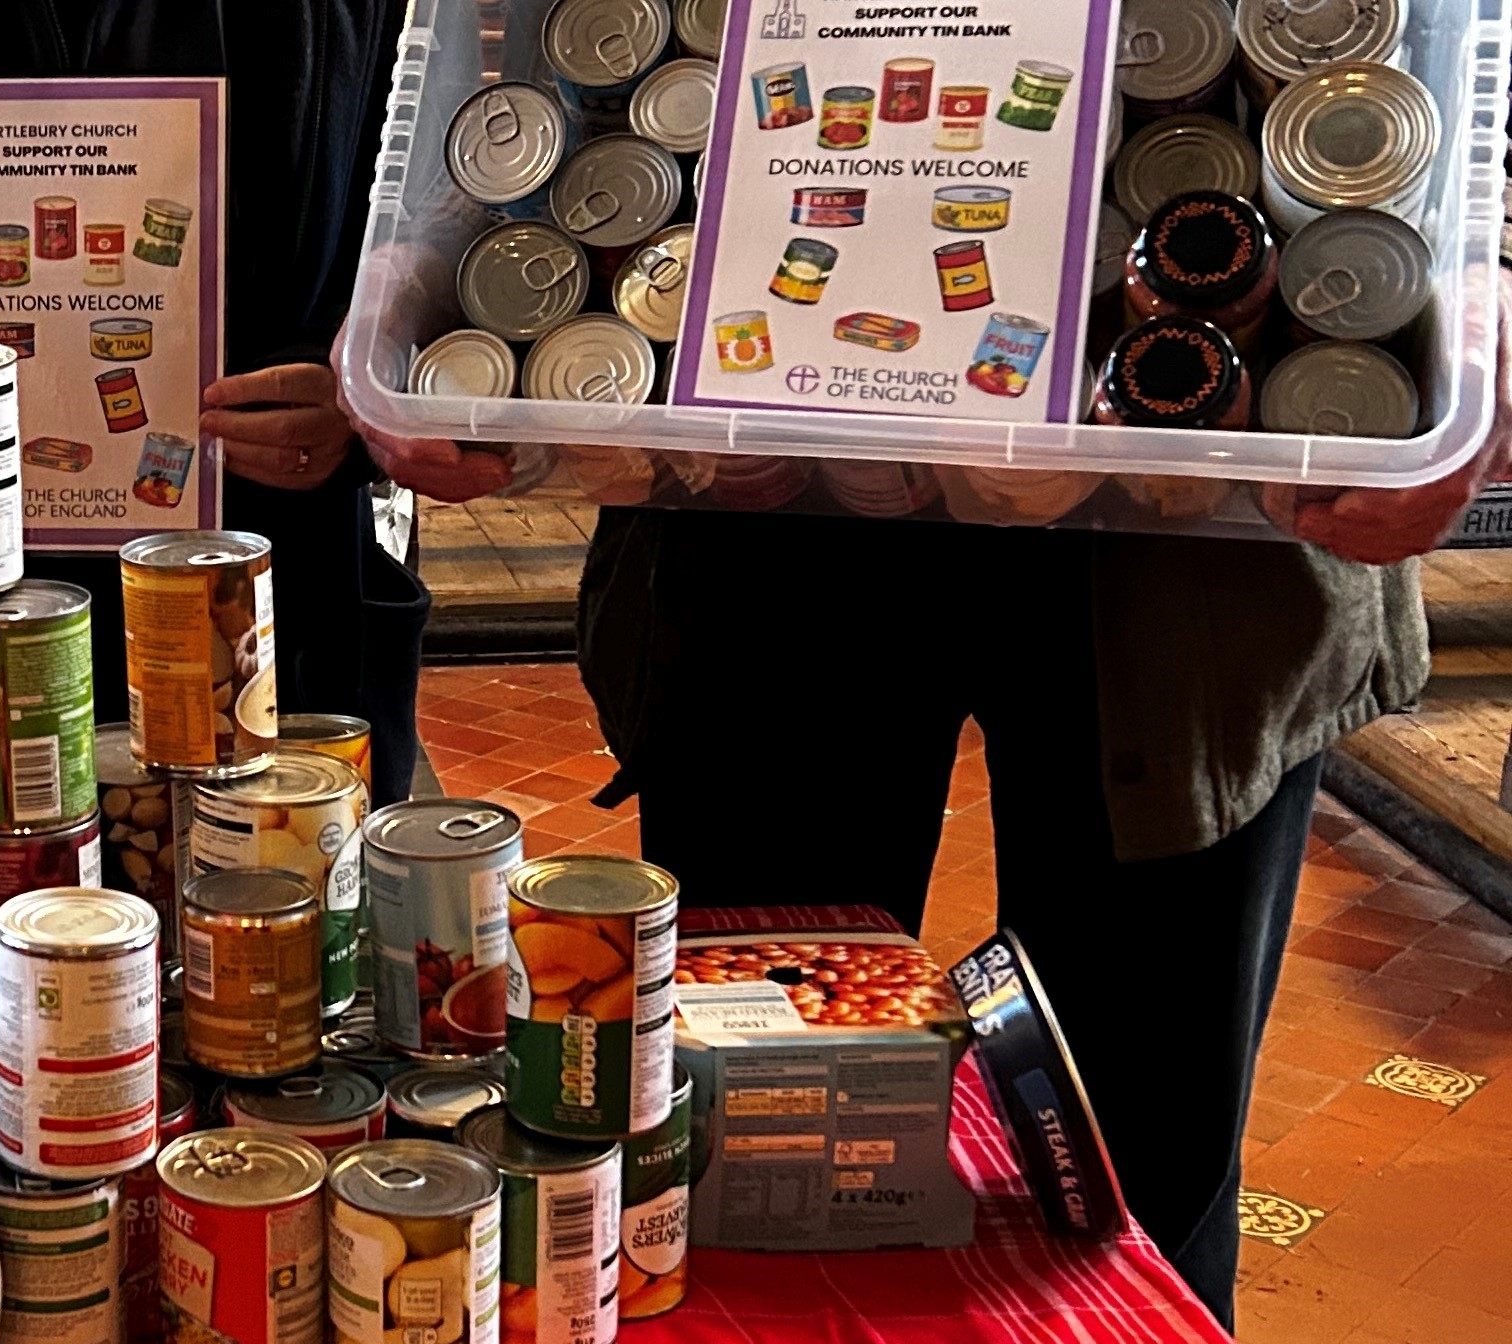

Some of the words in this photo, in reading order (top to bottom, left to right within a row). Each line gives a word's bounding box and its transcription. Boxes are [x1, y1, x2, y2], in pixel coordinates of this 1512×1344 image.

[855, 6, 937, 19] SUPPORT
[940, 6, 978, 19] OUR
[818, 26, 927, 39] COMMUNITY
[931, 25, 960, 37] TIN
[962, 24, 1011, 37] BANK
[71, 125, 137, 137] CHURCH
[3, 145, 73, 157] SUPPORT
[75, 145, 108, 157] OUR
[70, 164, 93, 176] TIN
[96, 164, 137, 176] BANK
[768, 158, 904, 176] DONATIONS
[911, 159, 1029, 179] WELCOME
[962, 208, 1002, 223] TUNA
[68, 294, 164, 311] WELCOME
[115, 339, 146, 351] TUNA
[983, 334, 1036, 357] FRUIT
[831, 366, 868, 382] THE
[873, 369, 958, 387] CHURCH
[827, 383, 855, 398] OF
[859, 385, 956, 405] ENGLAND
[147, 452, 185, 471] FRUIT
[24, 488, 56, 502] THE
[59, 488, 127, 503] CHURCH
[24, 505, 47, 518] OF
[51, 505, 127, 518] ENGLAND
[1038, 1108, 1074, 1172] STEAK
[832, 1191, 842, 1203] 4
[862, 1190, 905, 1205] 420g
